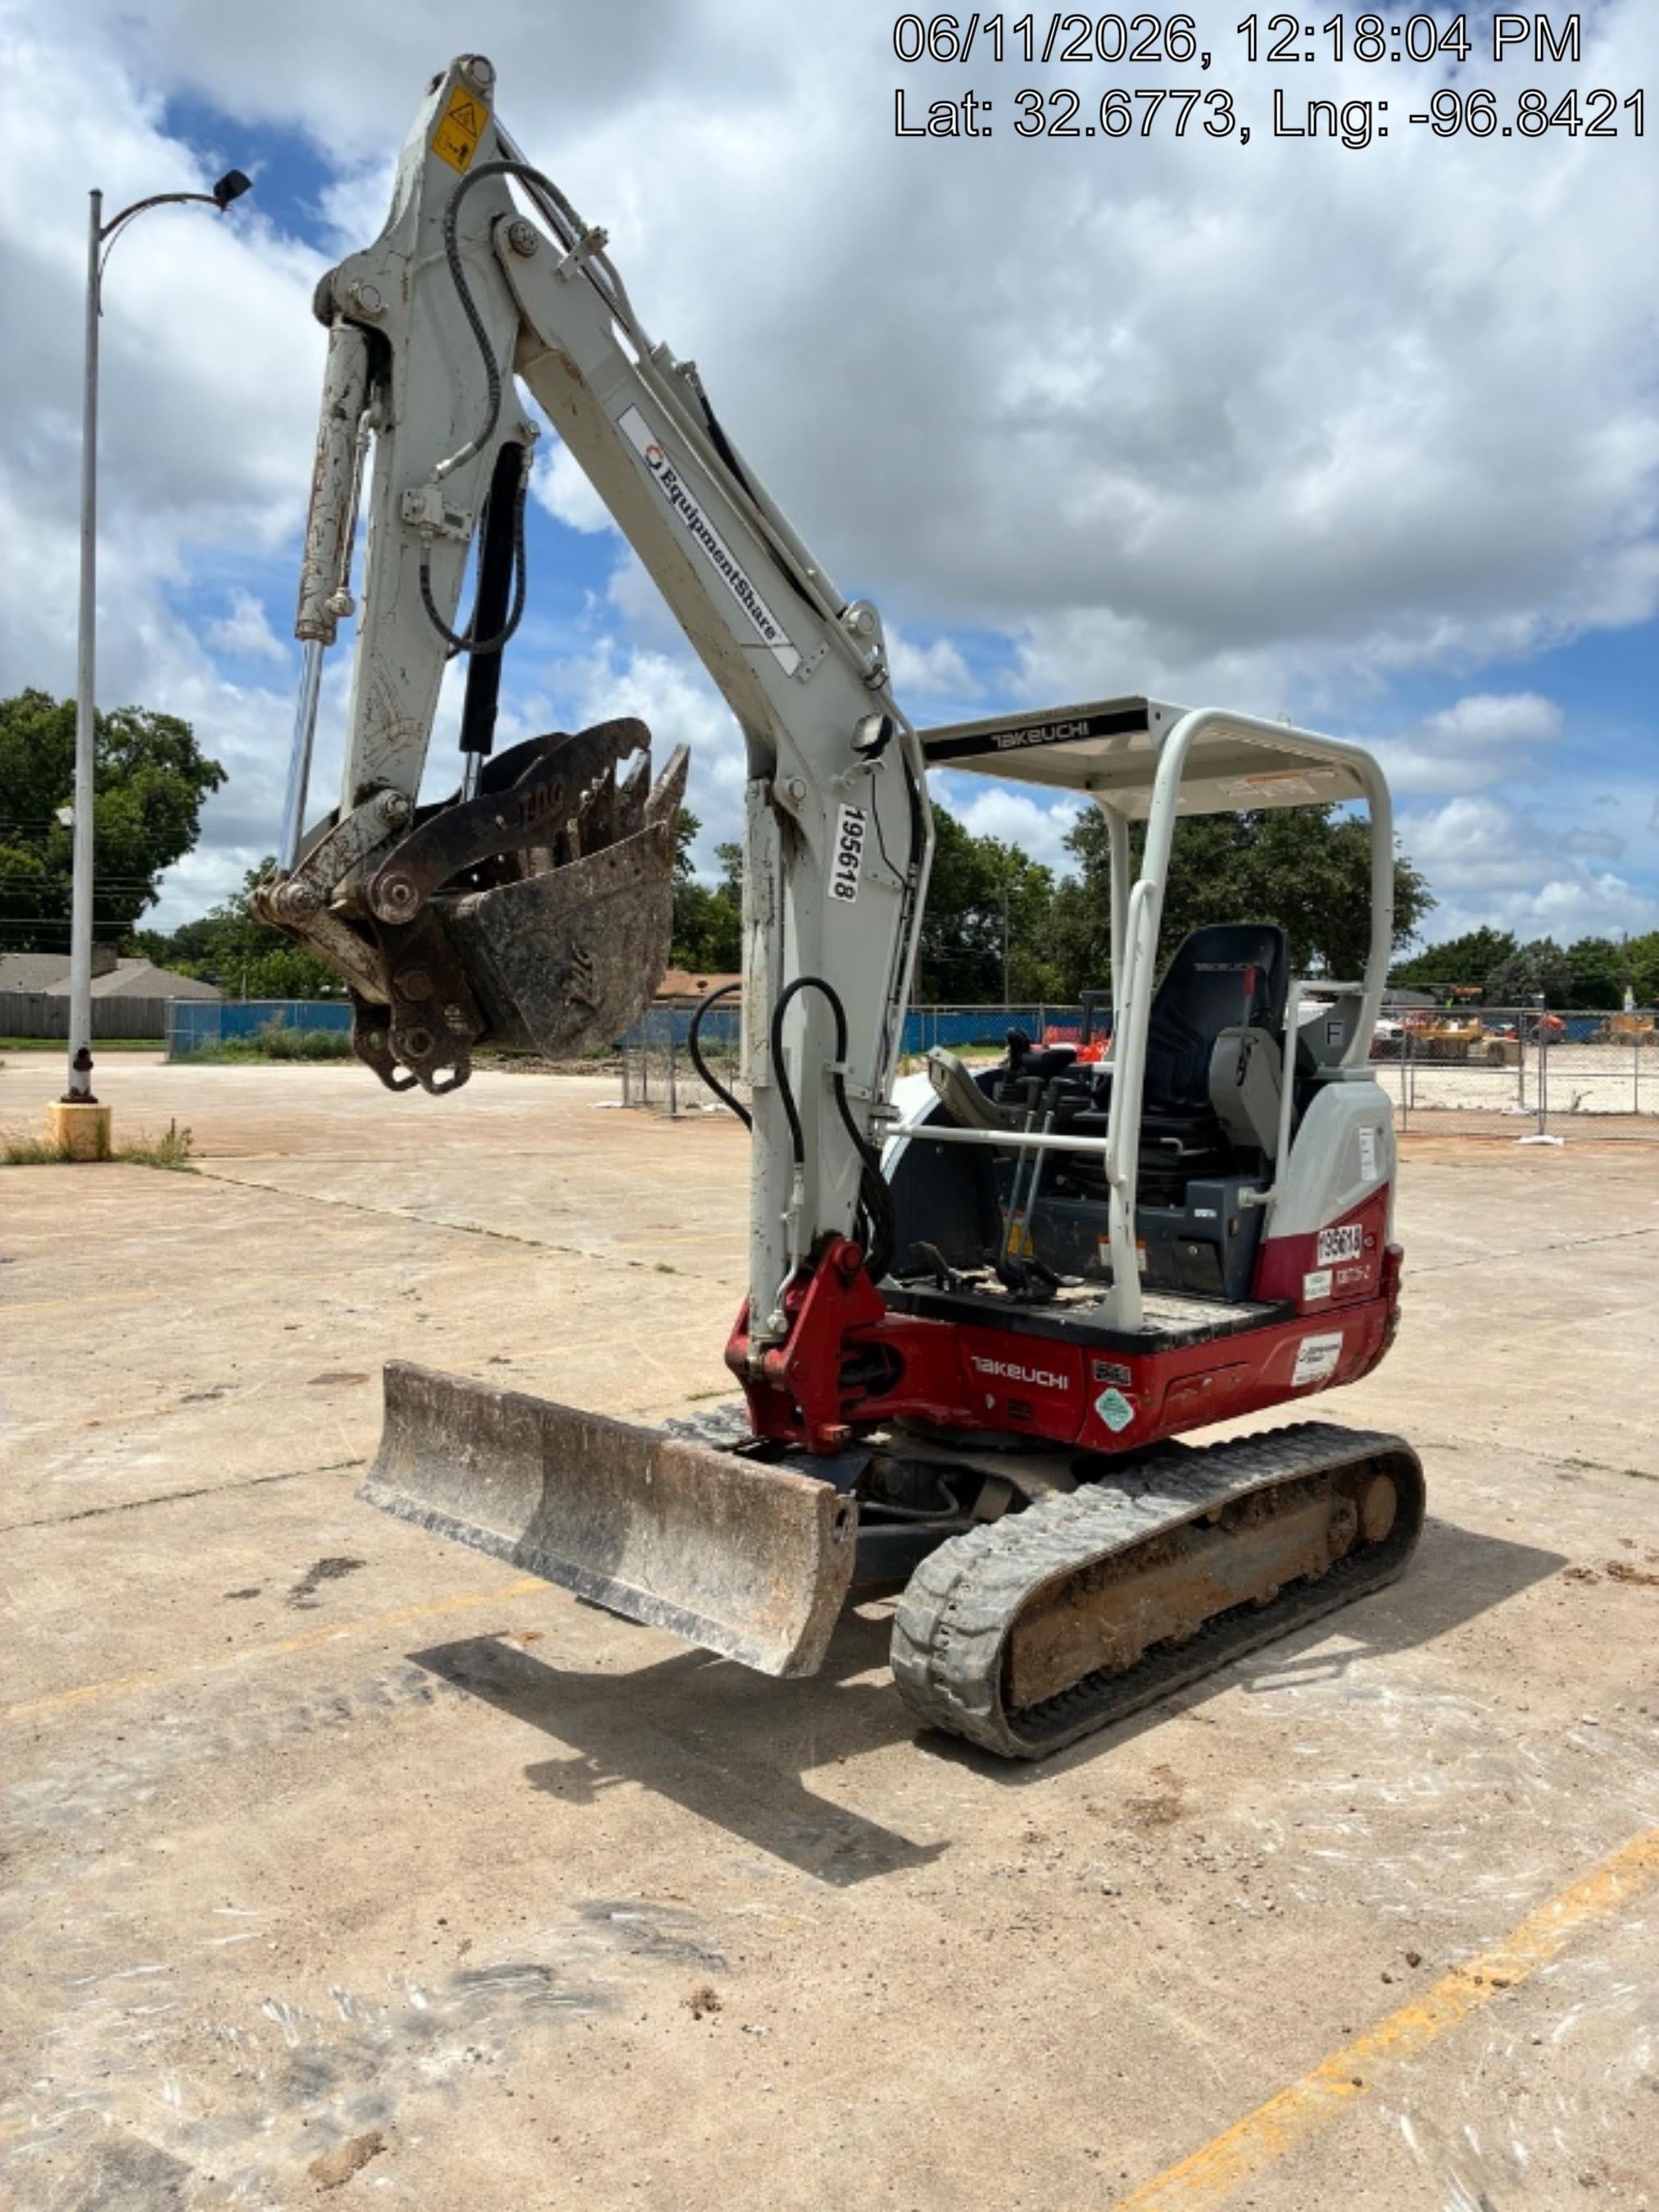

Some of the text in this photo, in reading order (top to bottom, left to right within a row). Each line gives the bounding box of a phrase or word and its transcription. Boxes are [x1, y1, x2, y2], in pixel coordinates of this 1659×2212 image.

[660, 469, 777, 640] EquipmentShare
[990, 720, 1089, 749] TAKEUCHI
[834, 809, 865, 900] 195618
[1326, 1022, 1343, 1045] F
[970, 1356, 1068, 1389] TAKEUCHI
